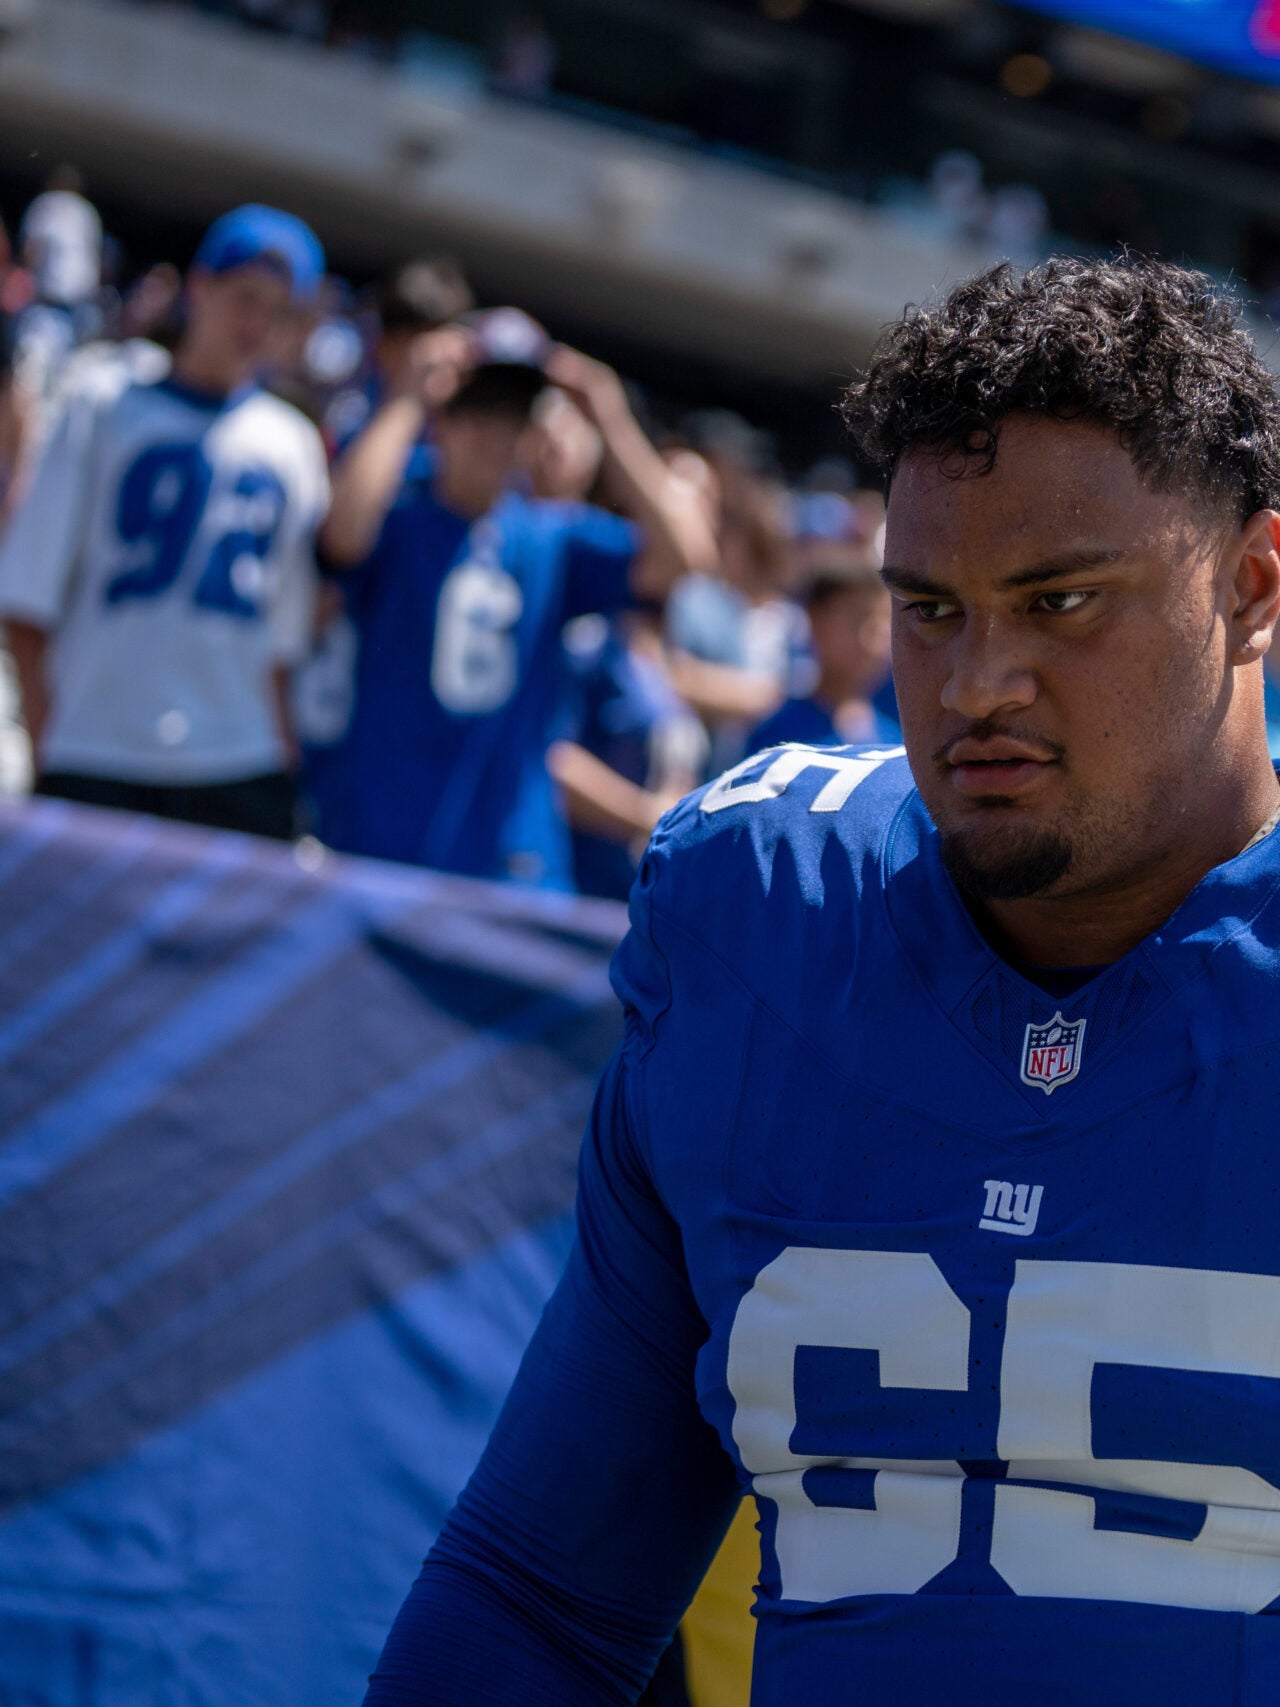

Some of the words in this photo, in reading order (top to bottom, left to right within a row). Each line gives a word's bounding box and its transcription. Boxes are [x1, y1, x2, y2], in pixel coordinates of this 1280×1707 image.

[107, 440, 290, 618] 92
[1029, 1046, 1071, 1079] NFL
[979, 1179, 1044, 1237] ny
